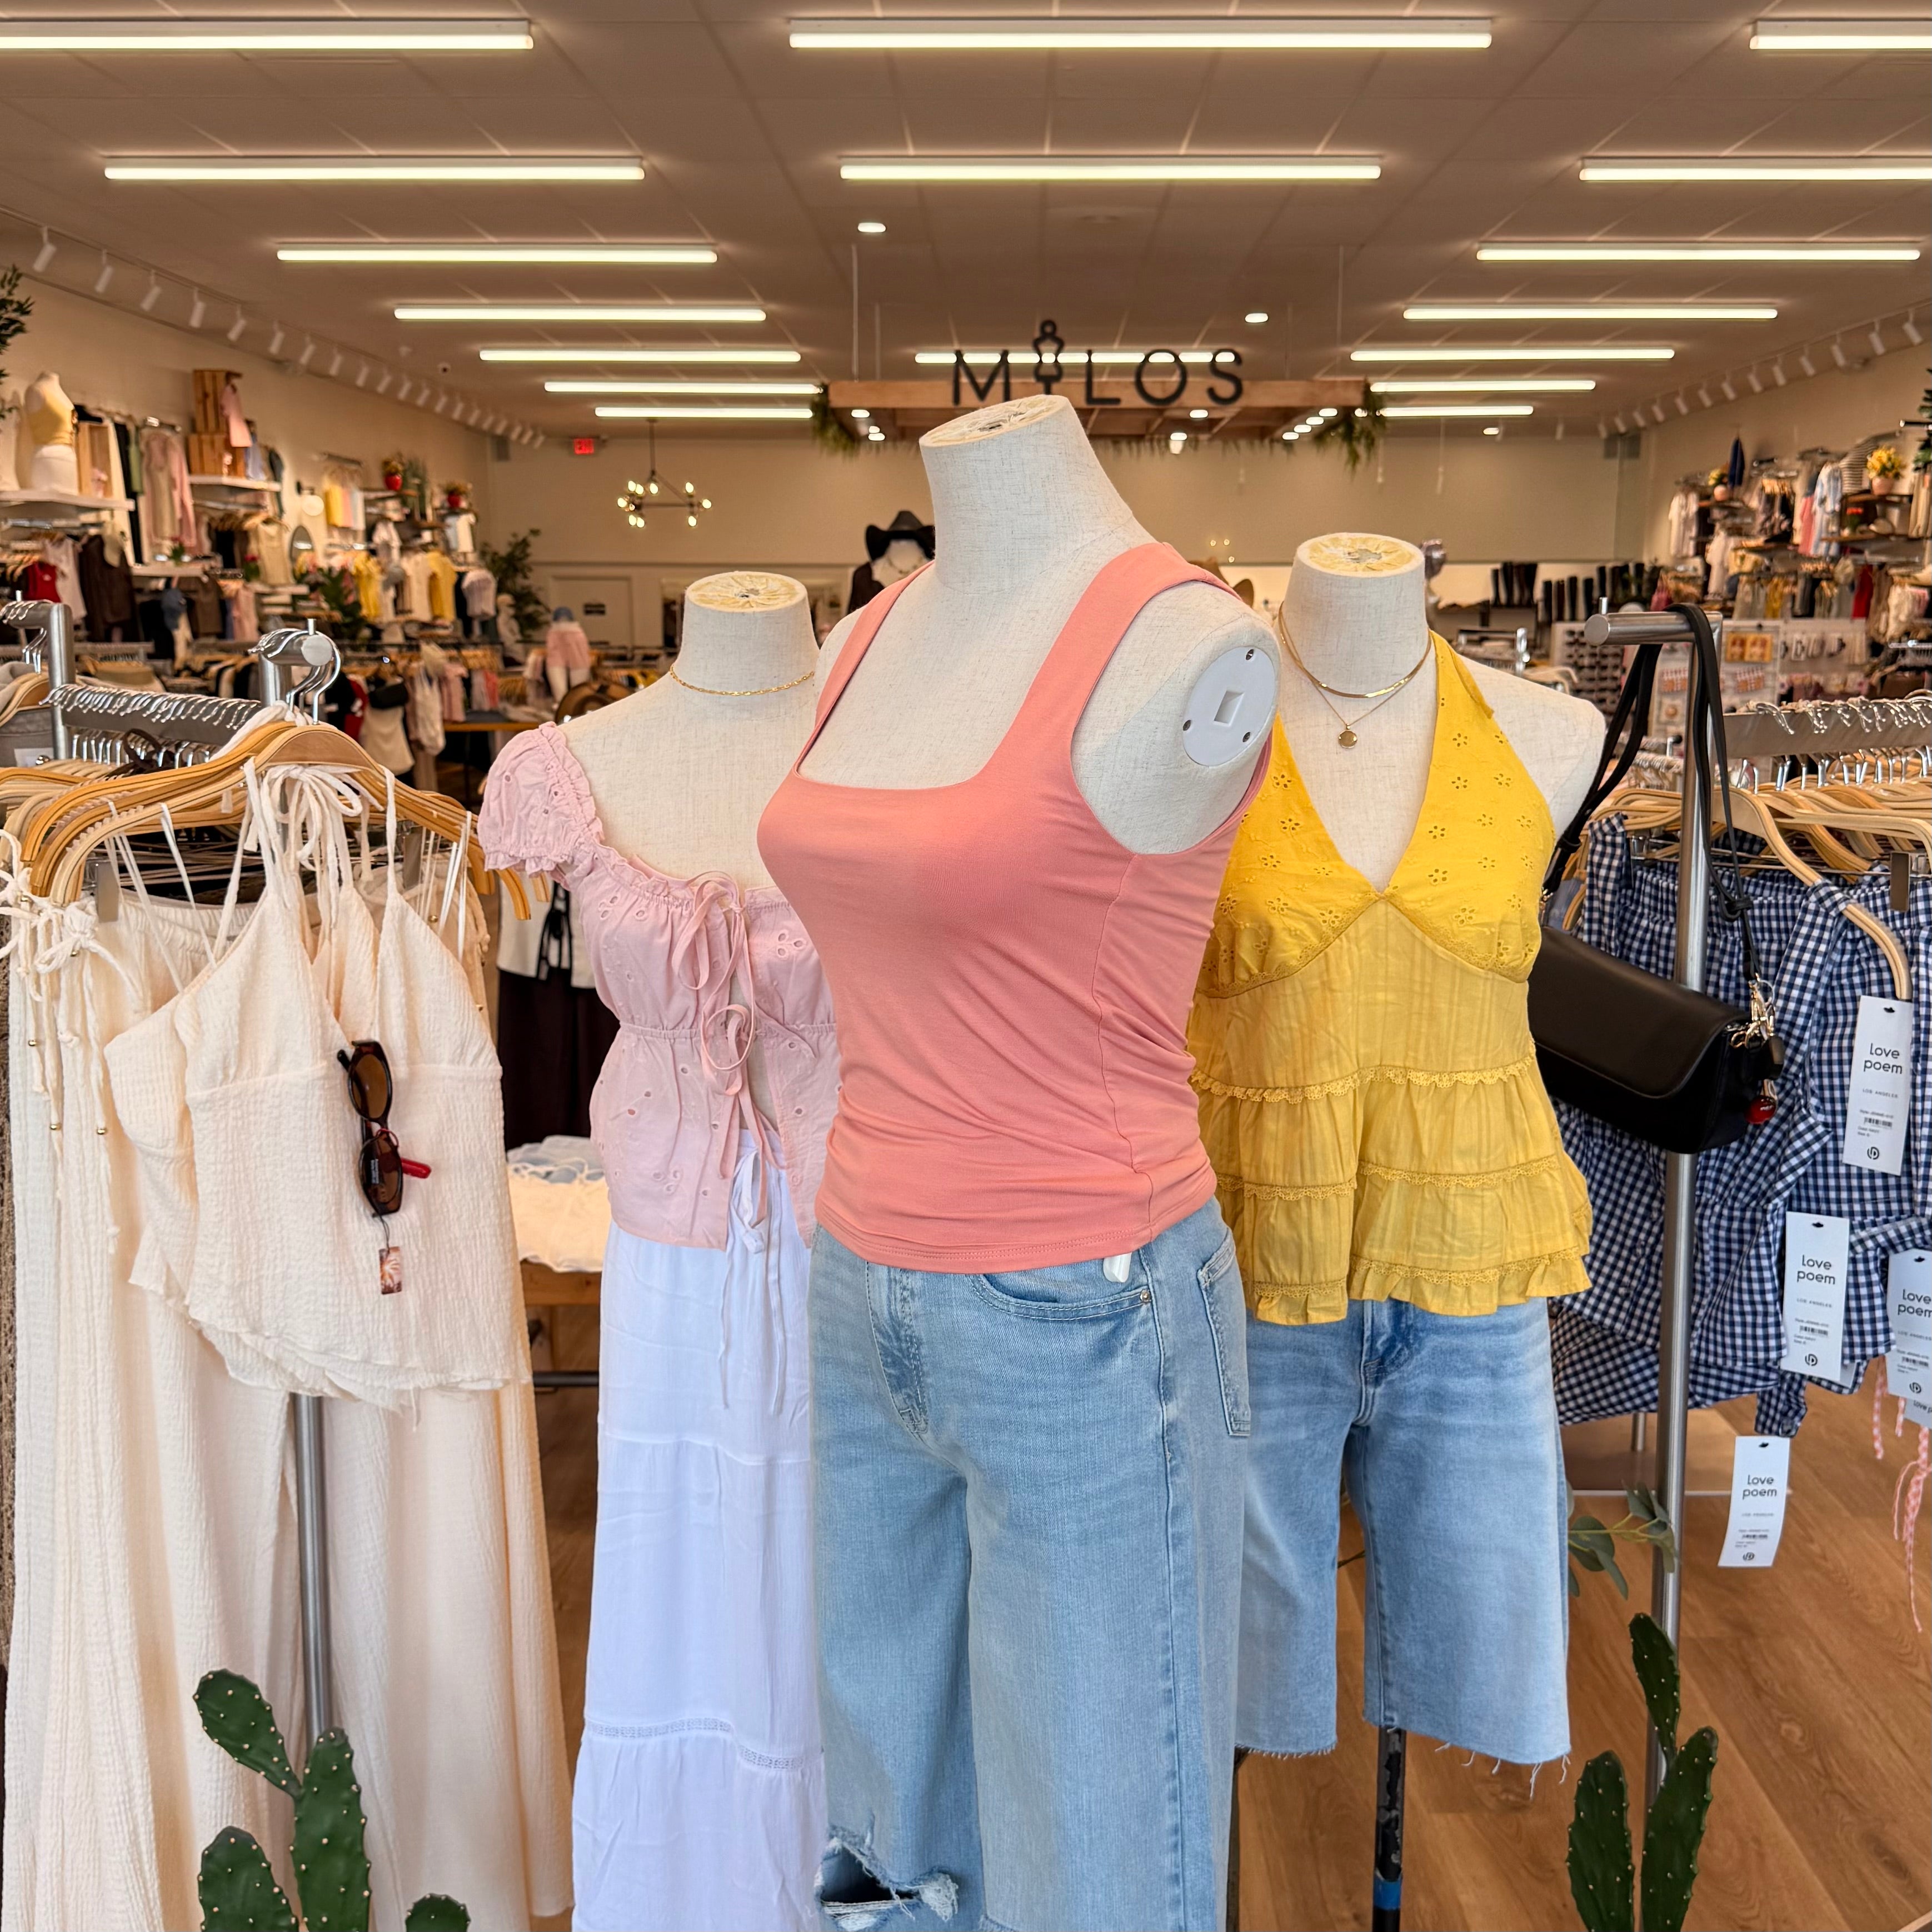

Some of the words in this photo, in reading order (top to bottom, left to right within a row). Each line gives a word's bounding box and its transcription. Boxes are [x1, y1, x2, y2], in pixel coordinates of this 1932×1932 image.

[1863, 1060, 1903, 1074] poem
[1797, 1271, 1835, 1285] poem
[1742, 1489, 1778, 1500] poem
